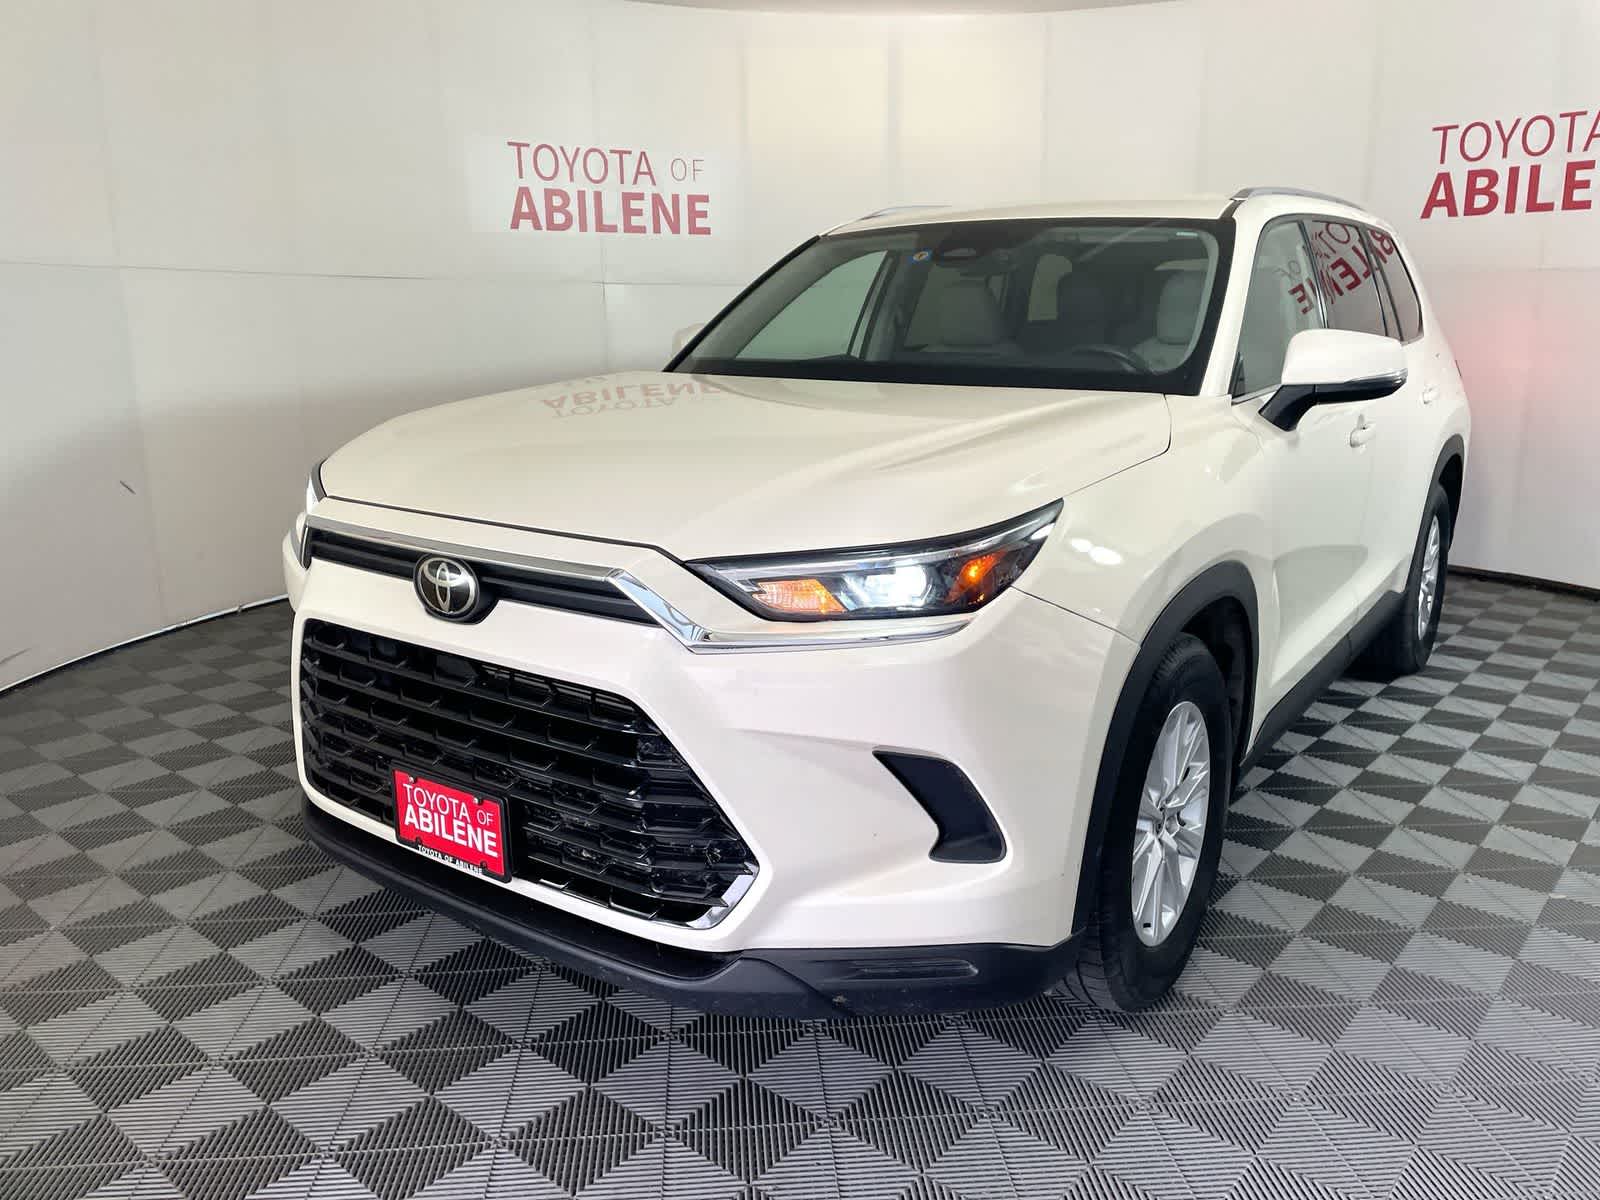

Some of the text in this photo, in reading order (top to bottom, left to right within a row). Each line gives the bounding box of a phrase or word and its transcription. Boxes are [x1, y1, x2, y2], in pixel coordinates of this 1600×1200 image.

[507, 141, 704, 186] TOYOTA OF
[510, 186, 712, 235] ABILENE
[1420, 160, 1596, 219] ABILE
[403, 783, 493, 826] TOYOTA OF
[404, 803, 499, 858] ABILENE
